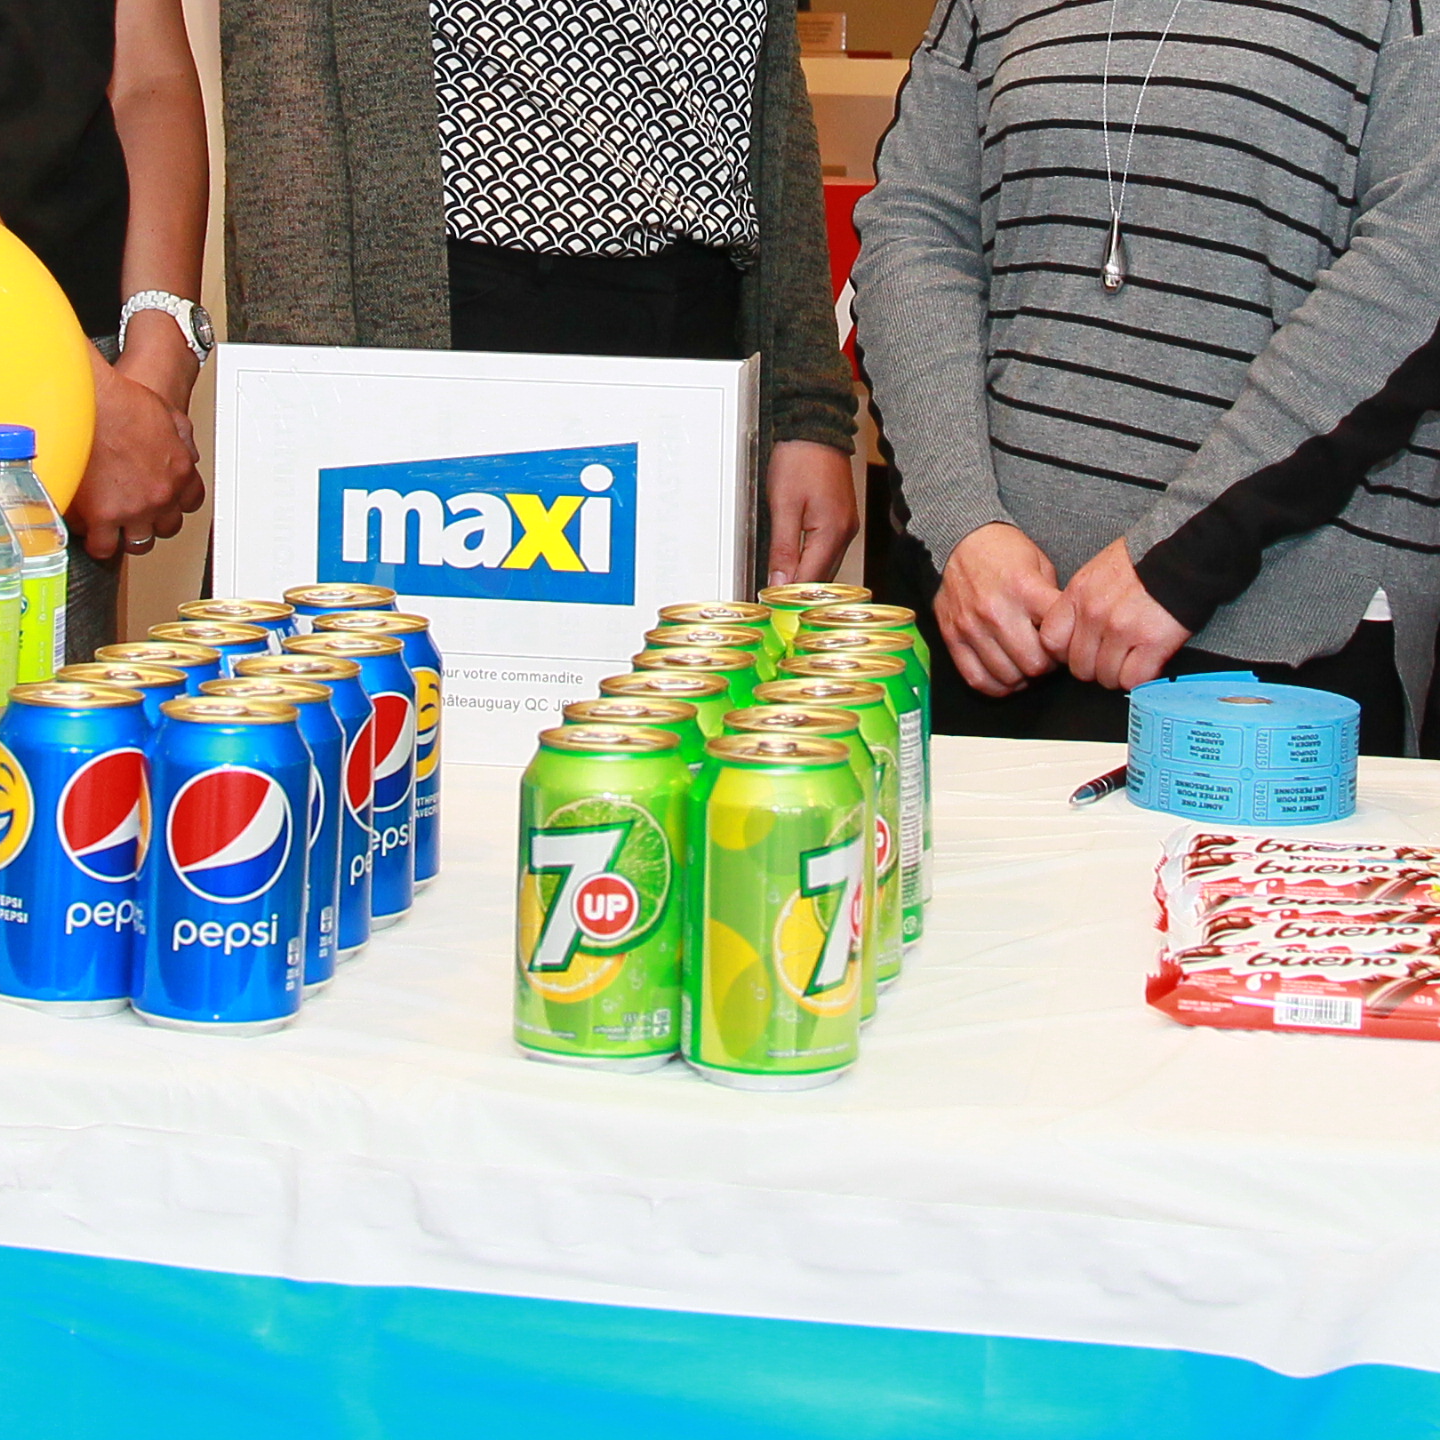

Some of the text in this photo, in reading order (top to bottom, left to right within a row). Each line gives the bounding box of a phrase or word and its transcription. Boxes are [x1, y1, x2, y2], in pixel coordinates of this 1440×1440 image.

[340, 462, 616, 574] maxi
[462, 670, 497, 681] votre
[501, 671, 584, 685] commandite
[524, 697, 549, 711] QC
[1190, 729, 1221, 738] COUPON
[1194, 736, 1224, 746] GARDER
[1190, 745, 1220, 754] COUPON
[1175, 780, 1233, 794] UNE PERSONNE
[1177, 789, 1199, 797] POUR
[1274, 786, 1327, 795] UNE PERSONNE
[1182, 799, 1223, 810] ADMIT ONE
[1276, 795, 1299, 803] POUR
[1253, 860, 1390, 875] bueno
[528, 819, 635, 973] 7 UP
[172, 913, 279, 956] pepsi
[1274, 921, 1421, 939] bueno
[1247, 952, 1398, 967] bueno
